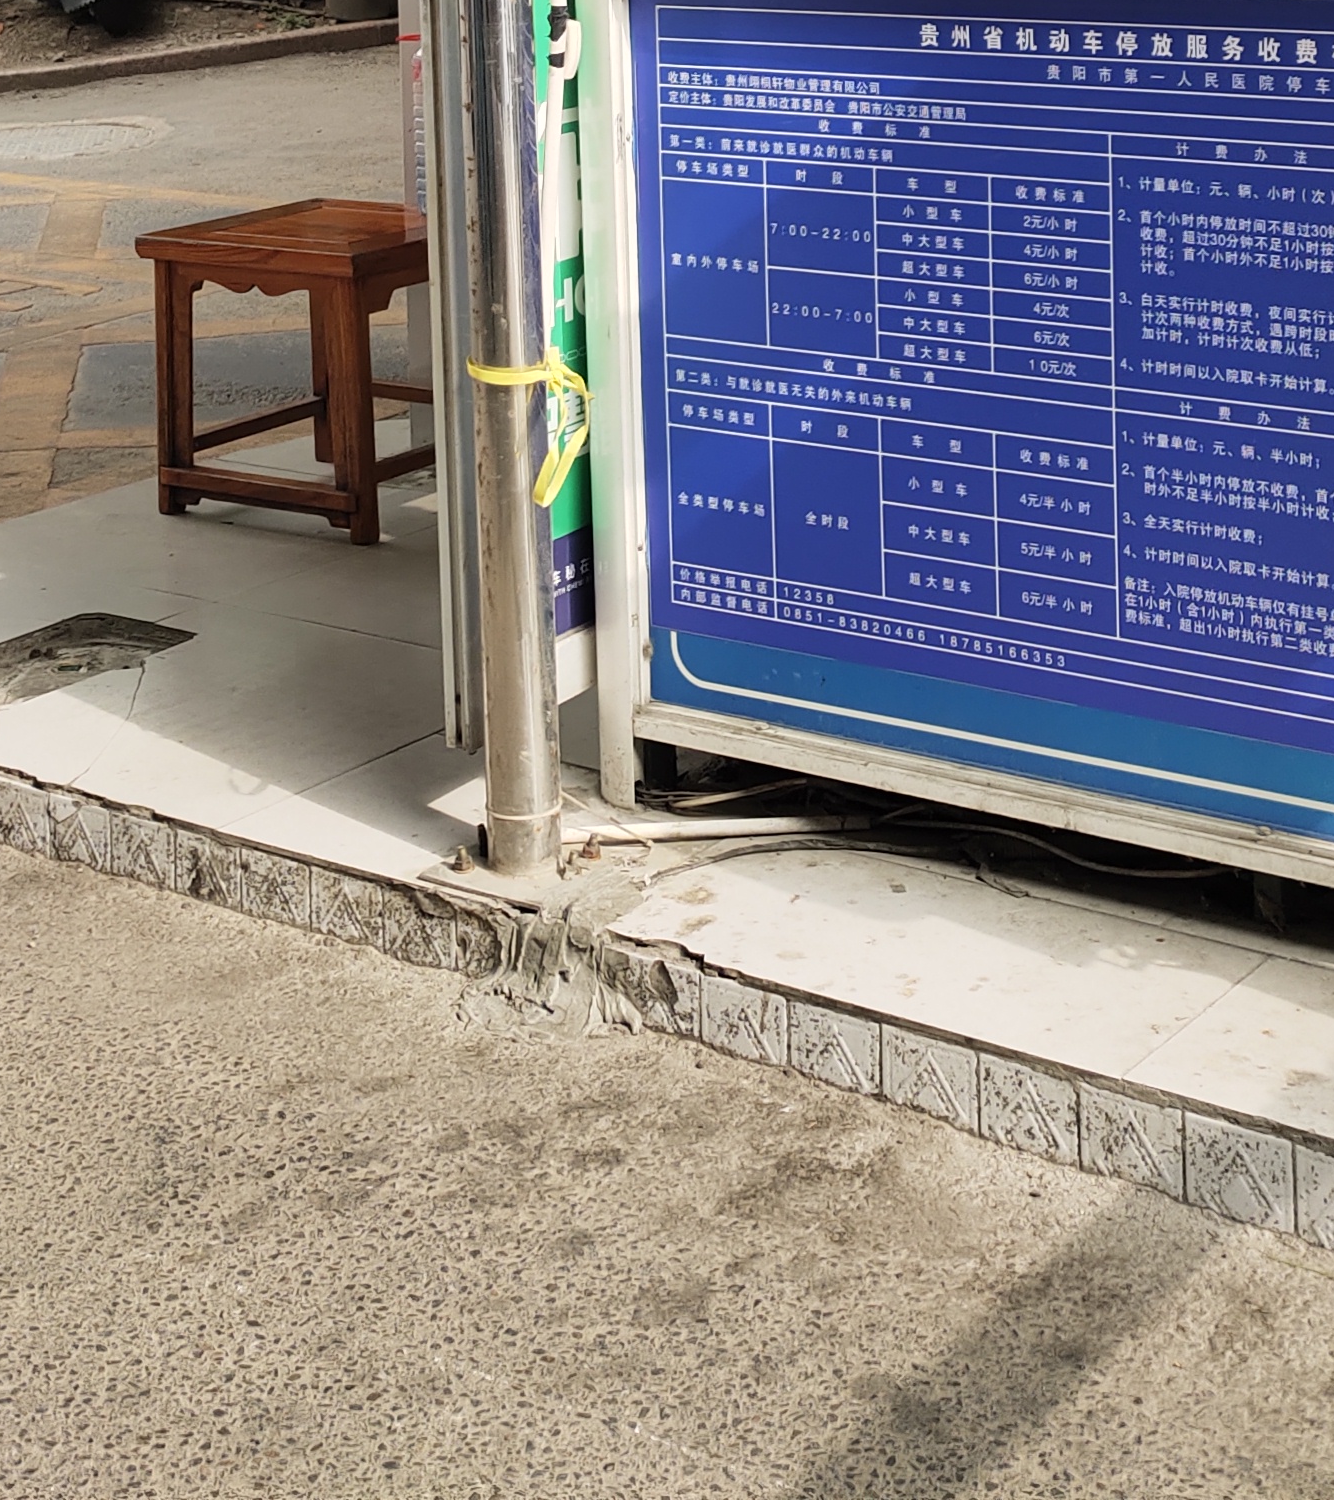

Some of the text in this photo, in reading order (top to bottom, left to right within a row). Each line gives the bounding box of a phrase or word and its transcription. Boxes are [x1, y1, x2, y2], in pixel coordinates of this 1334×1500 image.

[818, 119, 931, 139] 收费标准
[1176, 141, 1308, 165] 计费办法
[676, 160, 749, 177] 停车场类型
[795, 169, 843, 186] 时段
[907, 177, 957, 194] 车型
[1015, 185, 1085, 204] 收费标准
[902, 204, 962, 221] 小型车
[770, 222, 871, 243] 7:00-22:00
[1023, 215, 1077, 232] 2元/小时
[902, 233, 965, 251] 中大型车
[1023, 244, 1077, 261] 4元/小时
[671, 252, 760, 274] 室内外停车场
[902, 260, 965, 279] 超大型车
[1141, 260, 1175, 277] 计收。
[1024, 272, 1078, 290] 6元/小时
[904, 288, 964, 306] 小型车
[772, 303, 873, 324] 22:00-7:00
[1033, 302, 1070, 319] 4元/次
[904, 317, 966, 336] 中大型车
[1034, 330, 1070, 347] 6元/次
[904, 344, 967, 364] 超大型车
[823, 358, 936, 384] 收费标准
[682, 403, 755, 426] 停车场类型
[1179, 401, 1311, 430] 计费办法
[801, 420, 849, 438] 时段
[911, 434, 962, 453] 车型
[1019, 448, 1089, 471] 收费标准
[908, 476, 968, 498] 小型车
[677, 492, 766, 518] 全类型停车场
[1019, 494, 1091, 516] 4元/半小时
[805, 511, 849, 530] 全时段
[908, 525, 970, 546] 中大型车
[1020, 543, 1092, 566] 5元/半小时
[680, 568, 834, 605] 价格举报电话 12358
[909, 572, 972, 594] 超大型车
[1022, 590, 1093, 615] 6元/半小时
[680, 587, 1066, 667] 内部监督电话 0851-83820466 18785166353
